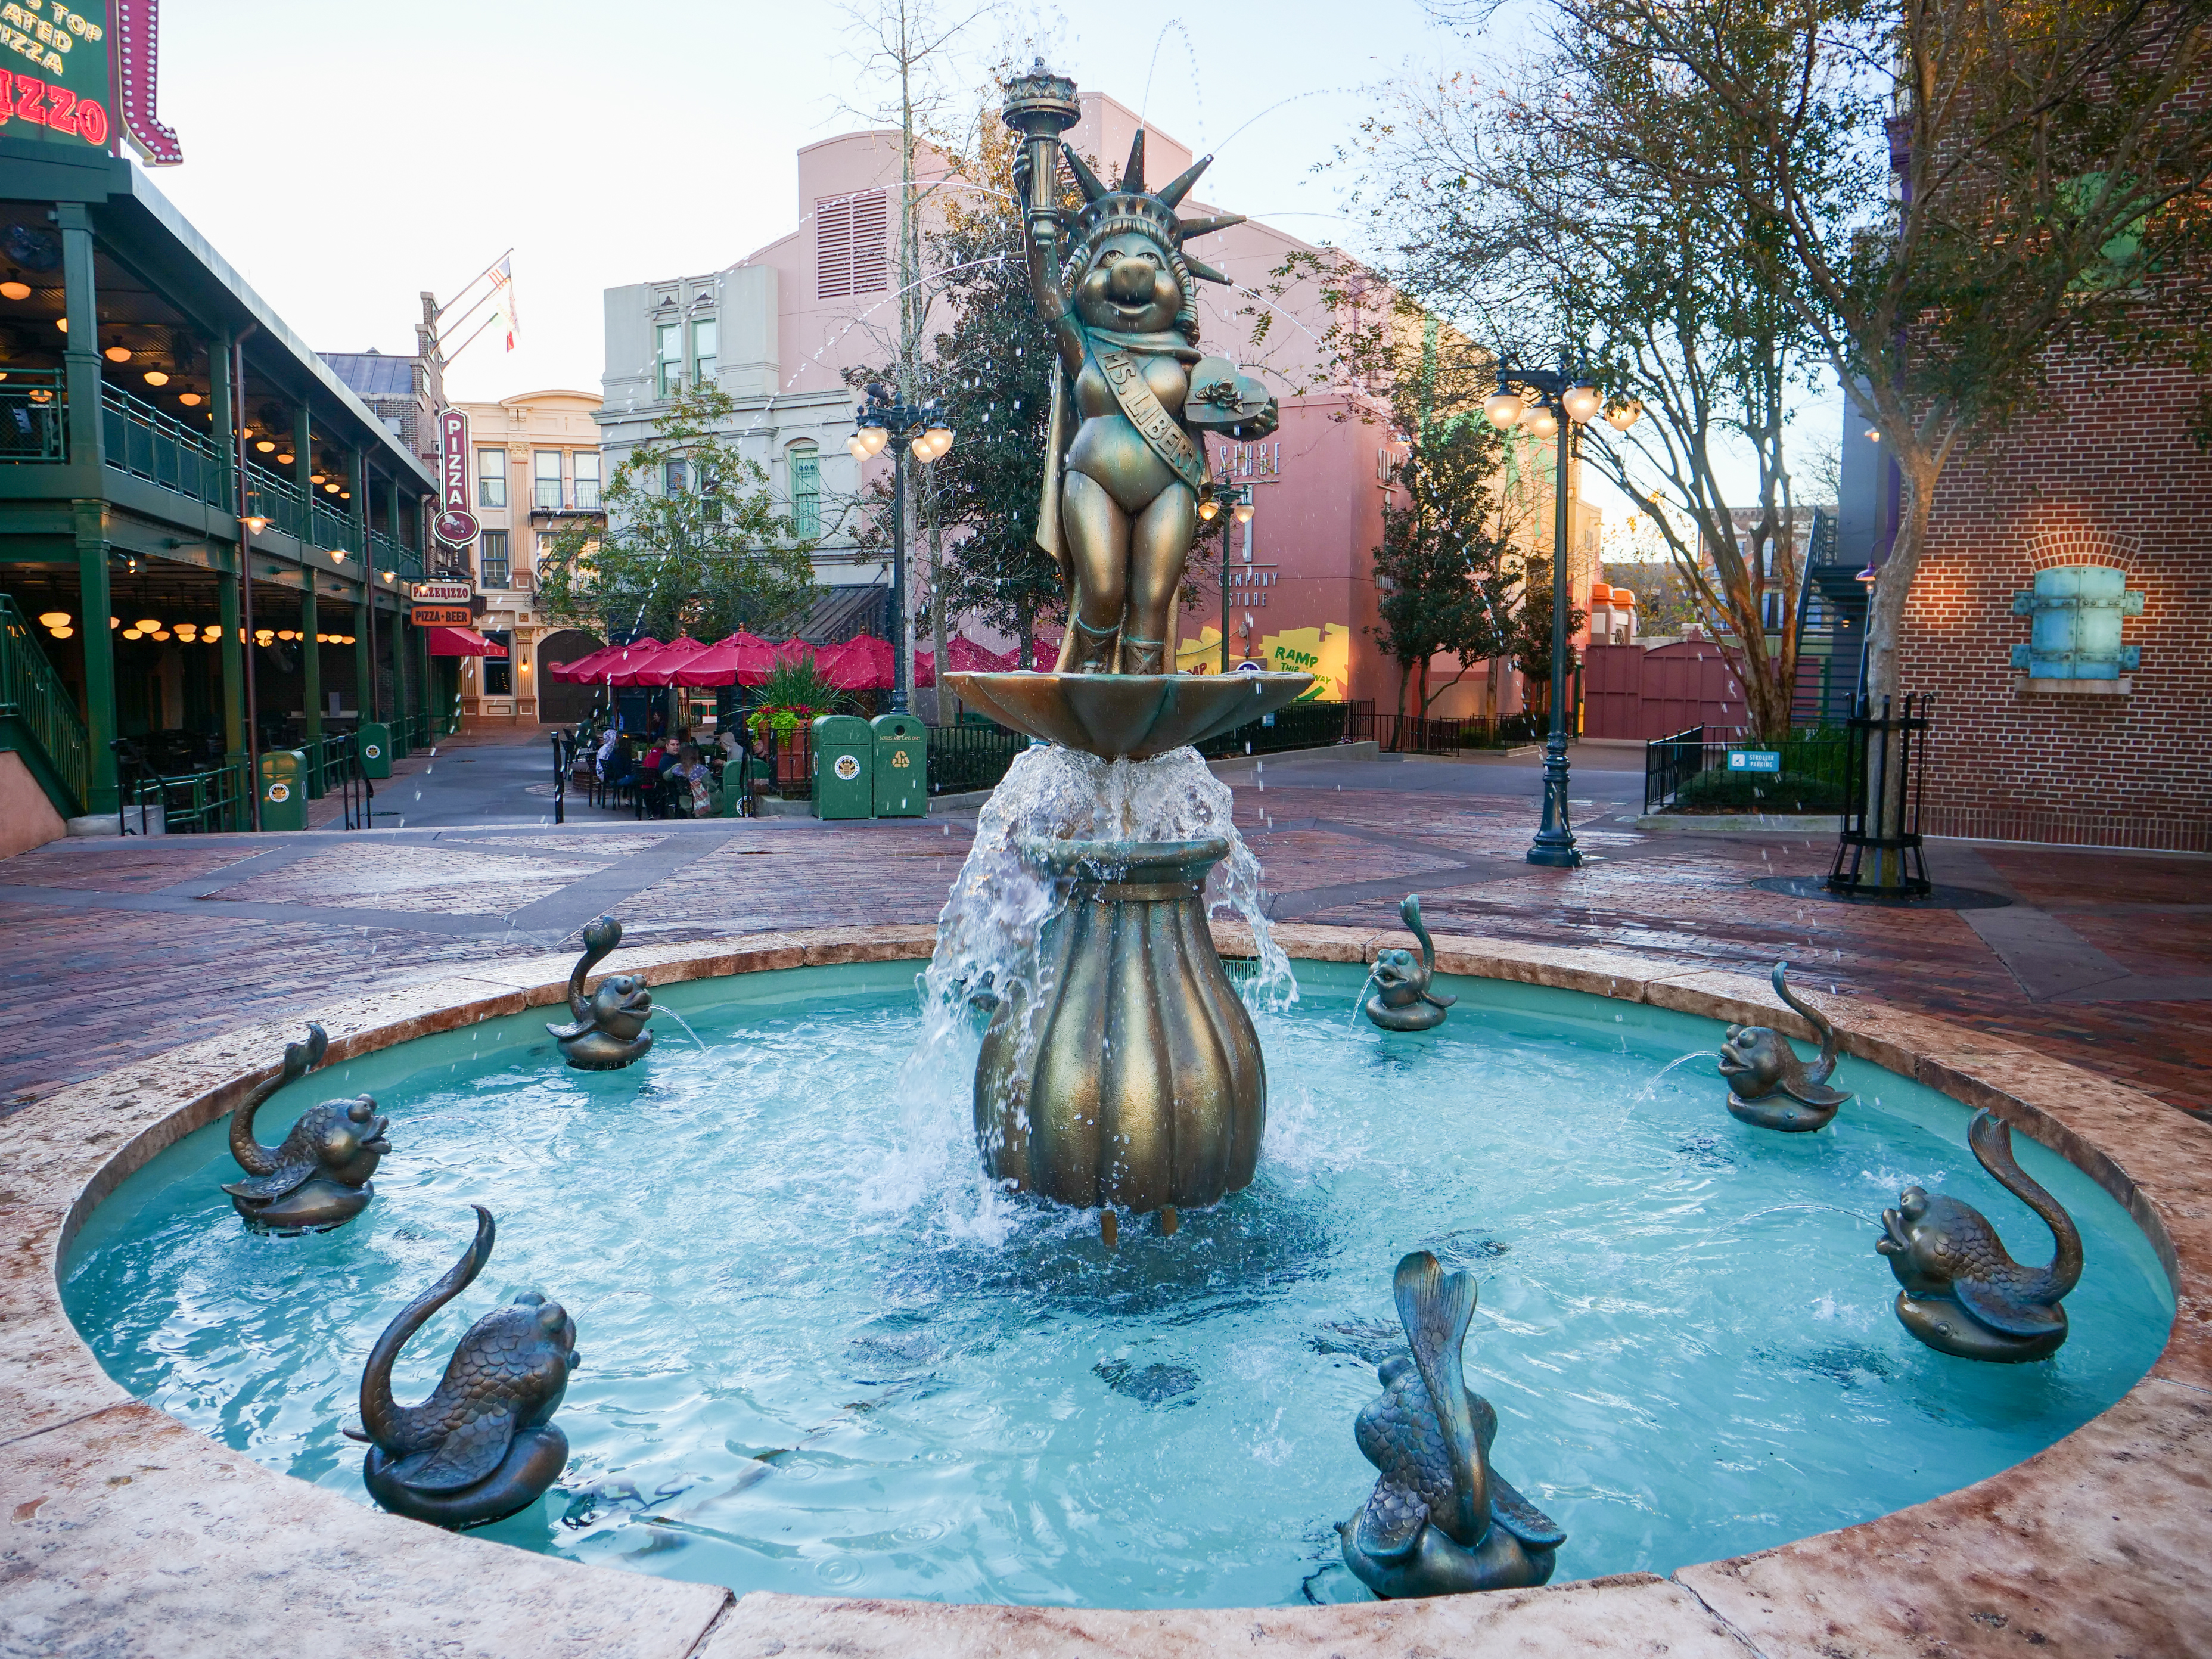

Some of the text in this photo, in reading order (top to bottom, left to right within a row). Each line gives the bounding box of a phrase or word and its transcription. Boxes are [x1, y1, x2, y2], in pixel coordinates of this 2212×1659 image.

[0, 2, 72, 53] ATED
[51, 1, 102, 44] TOP
[0, 23, 63, 77] IZZA
[0, 68, 108, 146] IZZO
[1102, 349, 1200, 479] MS. LIBERT
[448, 420, 463, 504] PIZZA
[1220, 443, 1280, 477] STAGE
[415, 611, 467, 622] PIZZA BEER
[1229, 592, 1266, 607] STORE
[1275, 646, 1319, 668] RAMP
